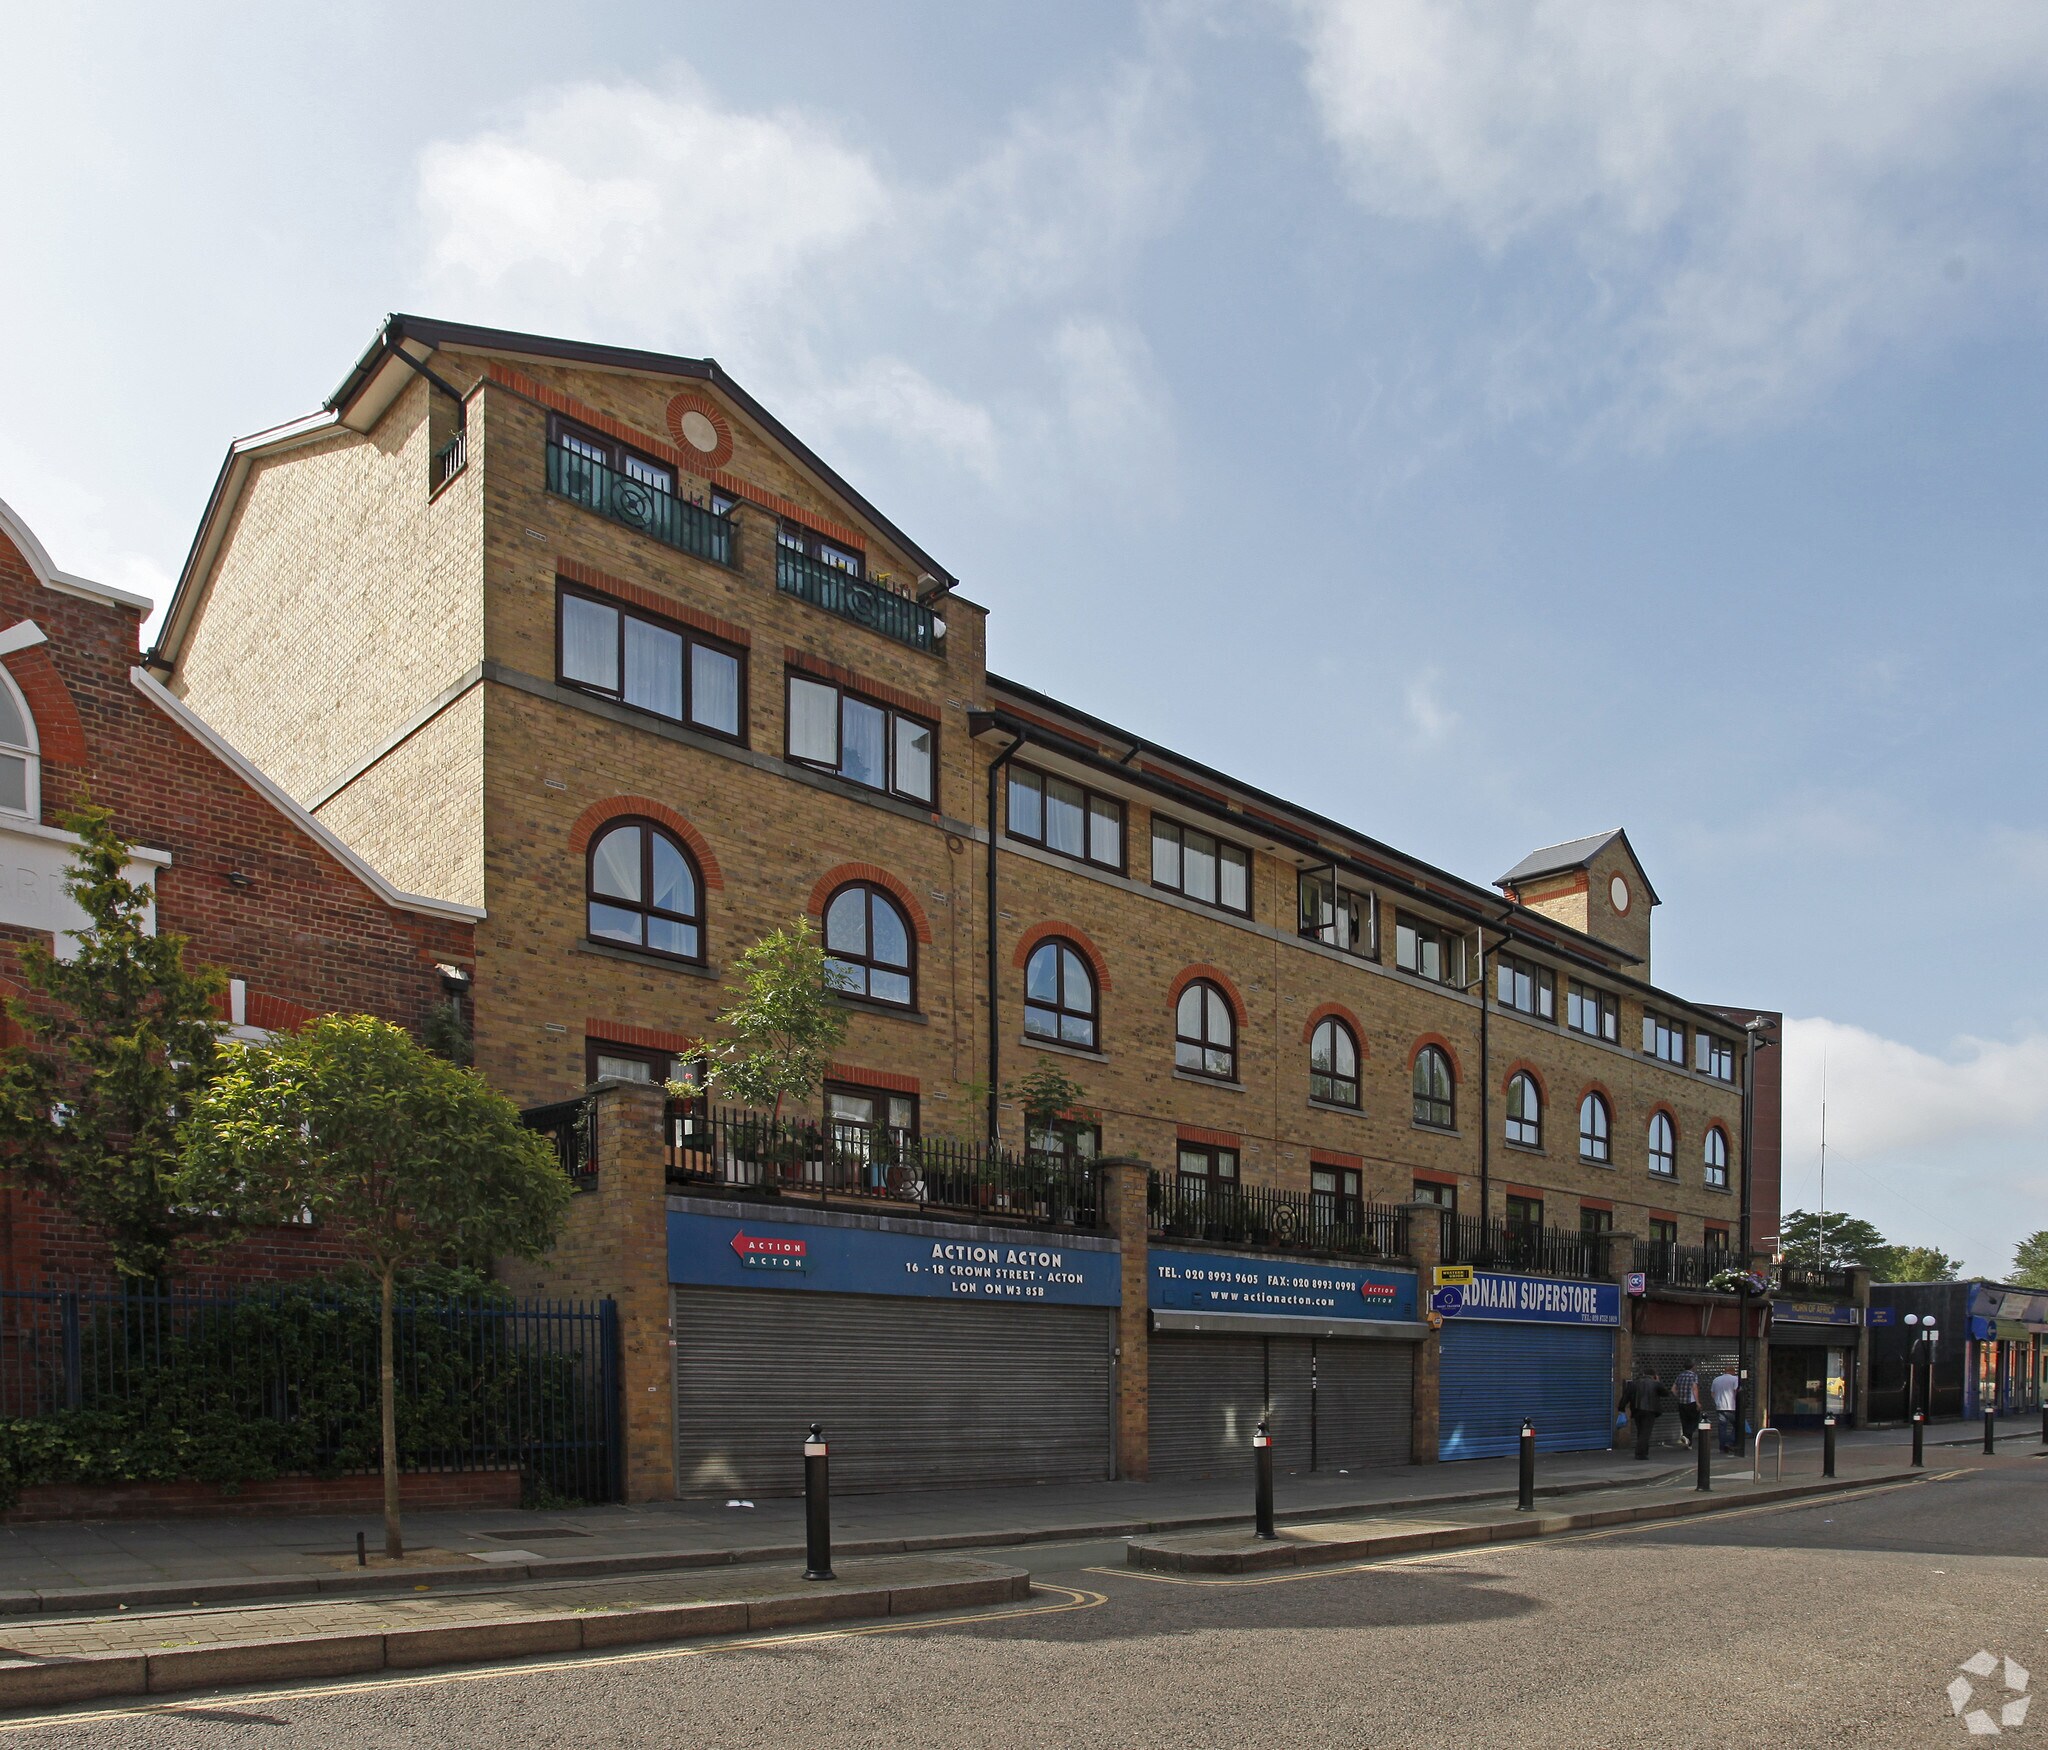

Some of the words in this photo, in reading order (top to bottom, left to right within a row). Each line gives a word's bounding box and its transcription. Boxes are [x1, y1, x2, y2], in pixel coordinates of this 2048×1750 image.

[748, 1241, 801, 1252] ACTION
[749, 1256, 802, 1267] ACTON
[931, 1243, 999, 1263] ACTION
[1006, 1249, 1062, 1268] ACTON
[905, 1262, 919, 1272] 16
[932, 1264, 944, 1275] 18
[949, 1265, 992, 1277] CROWN
[995, 1268, 1035, 1280] STREET
[1047, 1272, 1084, 1284] ACTON
[1158, 1266, 1181, 1279] TEL.
[1185, 1268, 1204, 1281] 020
[1207, 1270, 1232, 1283] 8993
[1235, 1273, 1259, 1285] 9605
[1267, 1275, 1290, 1287] FAX:
[1292, 1277, 1310, 1288] 020
[1312, 1279, 1333, 1290] 8993
[1335, 1281, 1356, 1292] 0998
[1006, 1285, 1021, 1296] W3
[1025, 1286, 1044, 1297] 8SB
[1462, 1277, 1517, 1309] ADNAAN
[1520, 1281, 1597, 1314] SUPERSTORE
[1243, 1292, 1335, 1307] actionacton.com
[1791, 1303, 1808, 1313] HORN
[1808, 1304, 1816, 1314] OF
[1816, 1304, 1836, 1315] AFRICA
